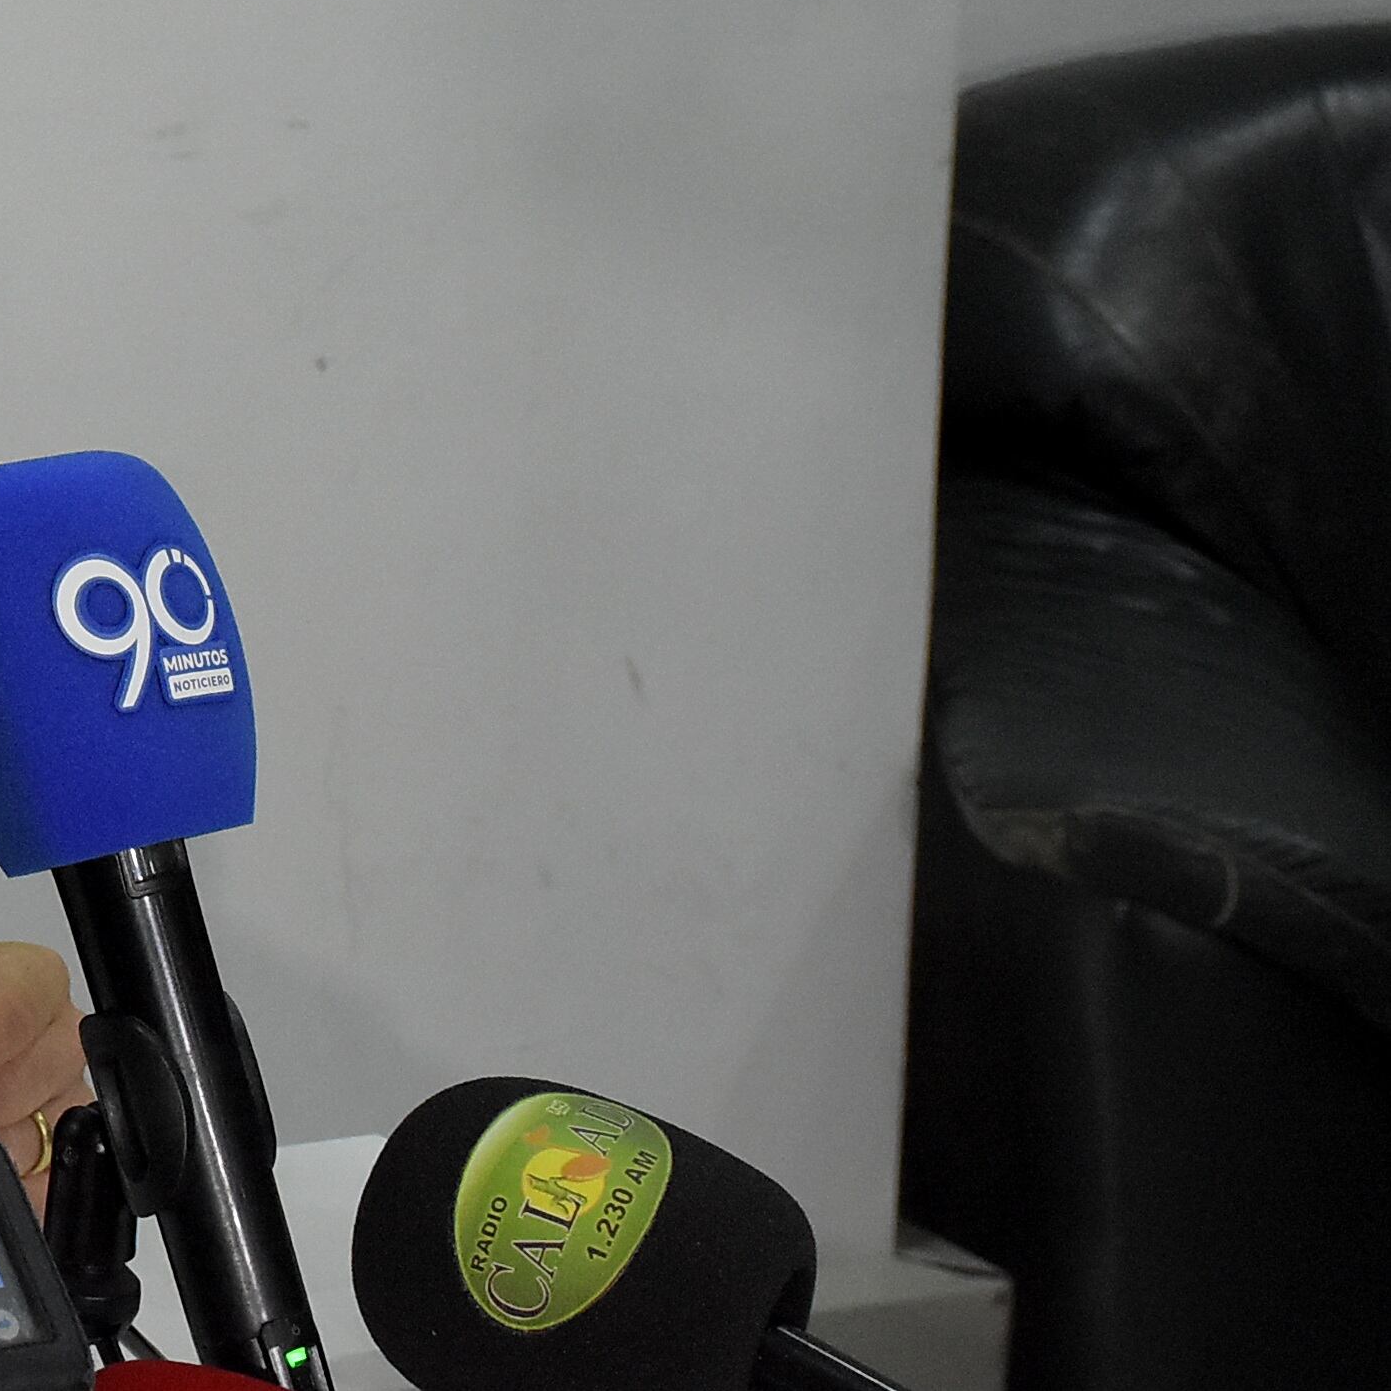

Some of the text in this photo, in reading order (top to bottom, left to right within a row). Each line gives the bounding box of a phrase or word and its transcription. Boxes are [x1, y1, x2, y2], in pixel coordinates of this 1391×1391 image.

[56, 548, 215, 708] 90
[163, 649, 229, 673] MINUTOS
[173, 674, 230, 693] NOTICIERO
[470, 1196, 508, 1272] RADIO
[587, 1149, 659, 1261] 1.230 AM
